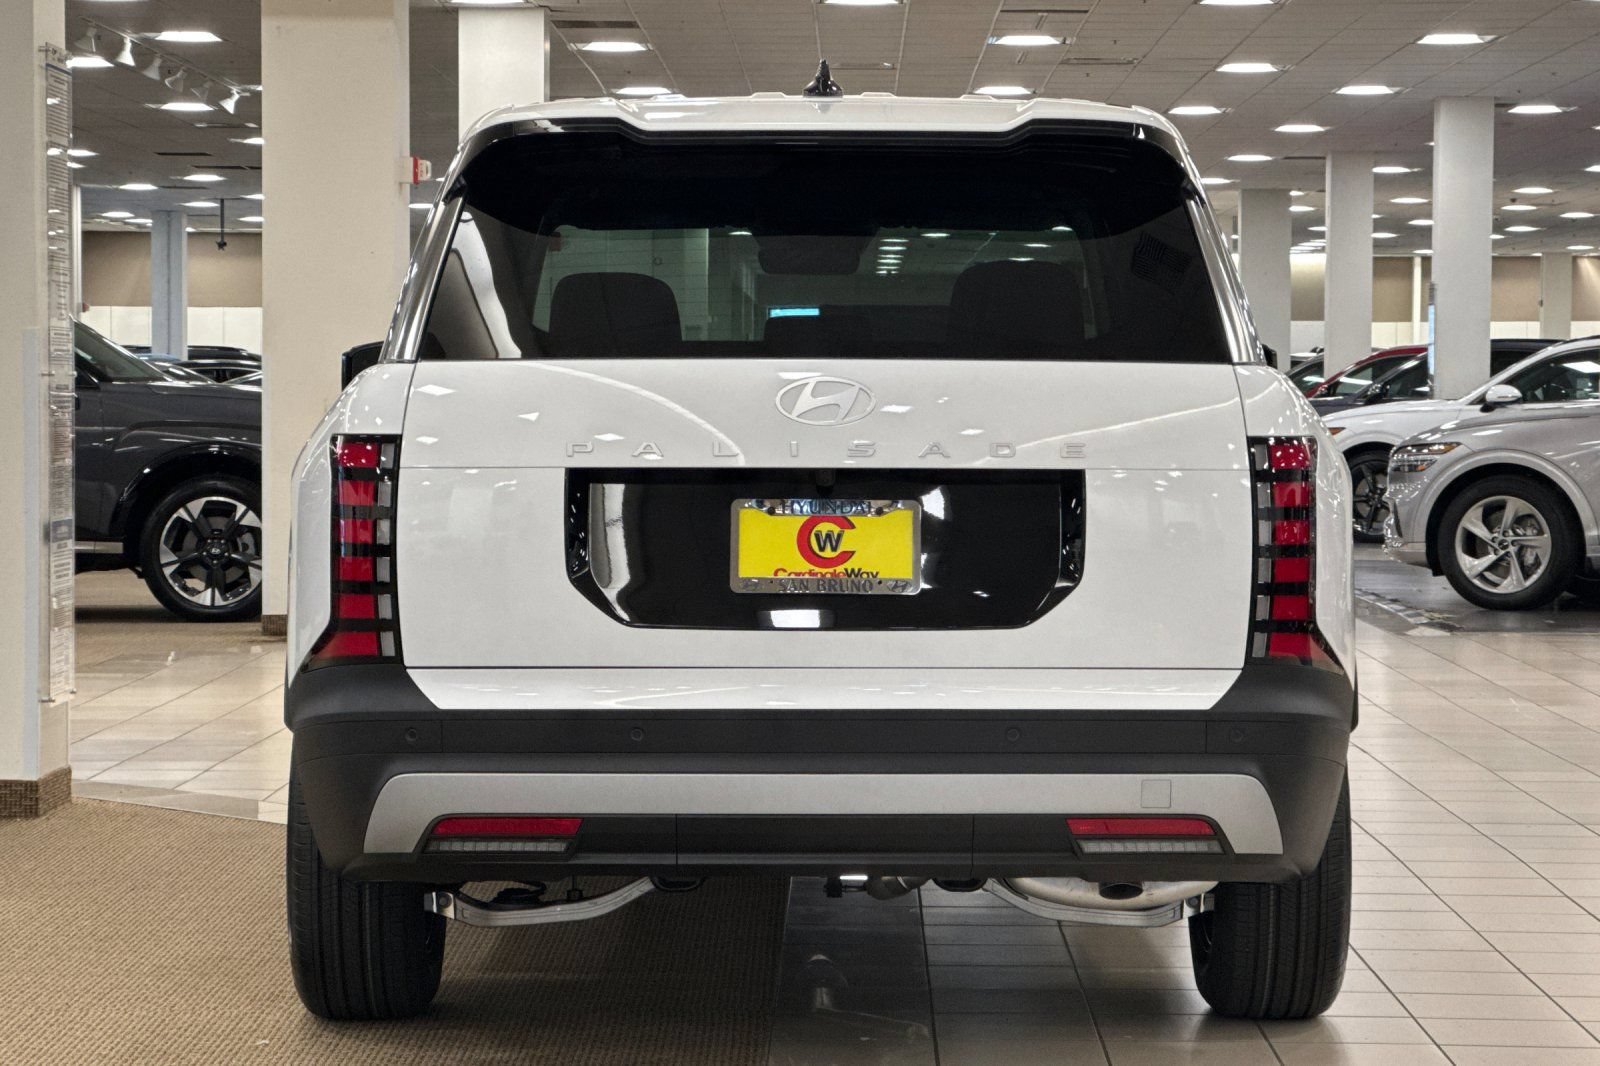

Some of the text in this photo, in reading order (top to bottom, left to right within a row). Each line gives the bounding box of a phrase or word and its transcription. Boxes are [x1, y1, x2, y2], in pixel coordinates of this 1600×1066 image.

[566, 440, 1087, 459] PALISADE
[780, 500, 873, 514] HYUNDAI
[778, 580, 874, 593] SAN BRUNO
